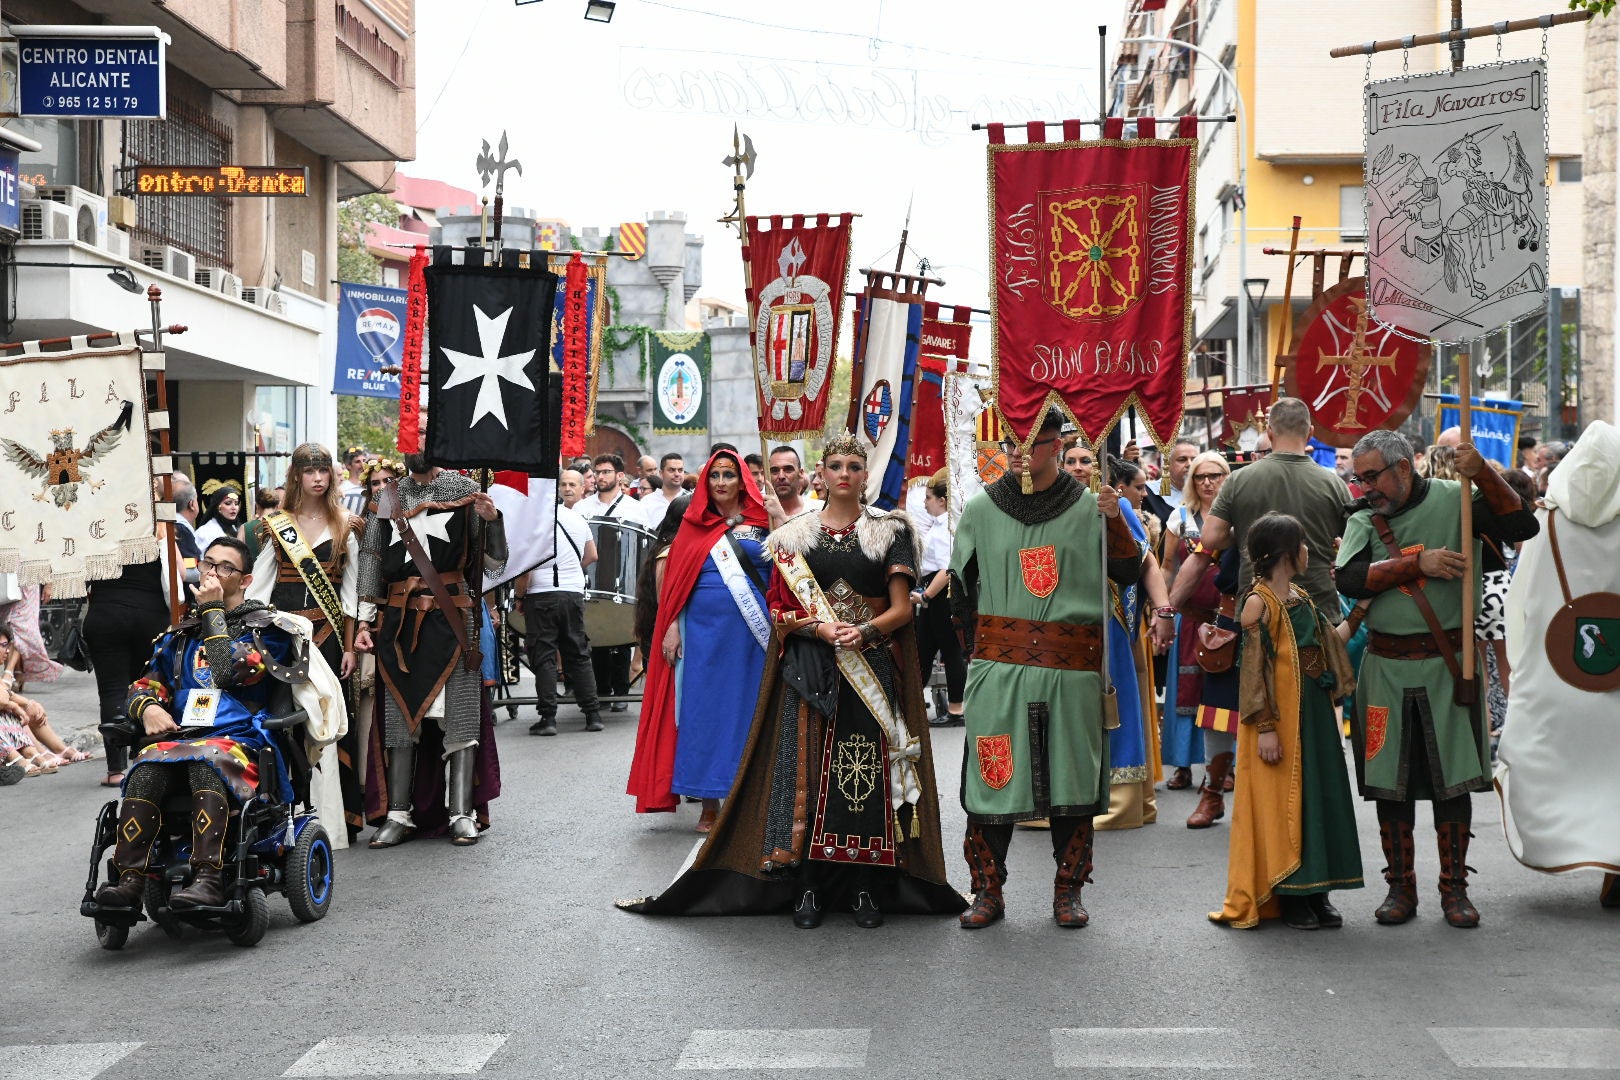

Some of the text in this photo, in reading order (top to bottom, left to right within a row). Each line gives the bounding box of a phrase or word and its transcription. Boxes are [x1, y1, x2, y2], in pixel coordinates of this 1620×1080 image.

[22, 48, 158, 65] CENTRO DENTAL
[50, 72, 131, 88] ALICANTE
[58, 96, 138, 109] 965 12 51 79
[1380, 87, 1527, 124] Fila Navarros
[1499, 278, 1529, 299] 2024
[362, 320, 395, 332] RE/MAX
[404, 283, 421, 413] CABALLEROS
[567, 290, 582, 439] HOSPITALARIOS
[1031, 341, 1088, 381] SAN
[347, 368, 401, 384] RE/MAX
[362, 382, 386, 391] BLUE
